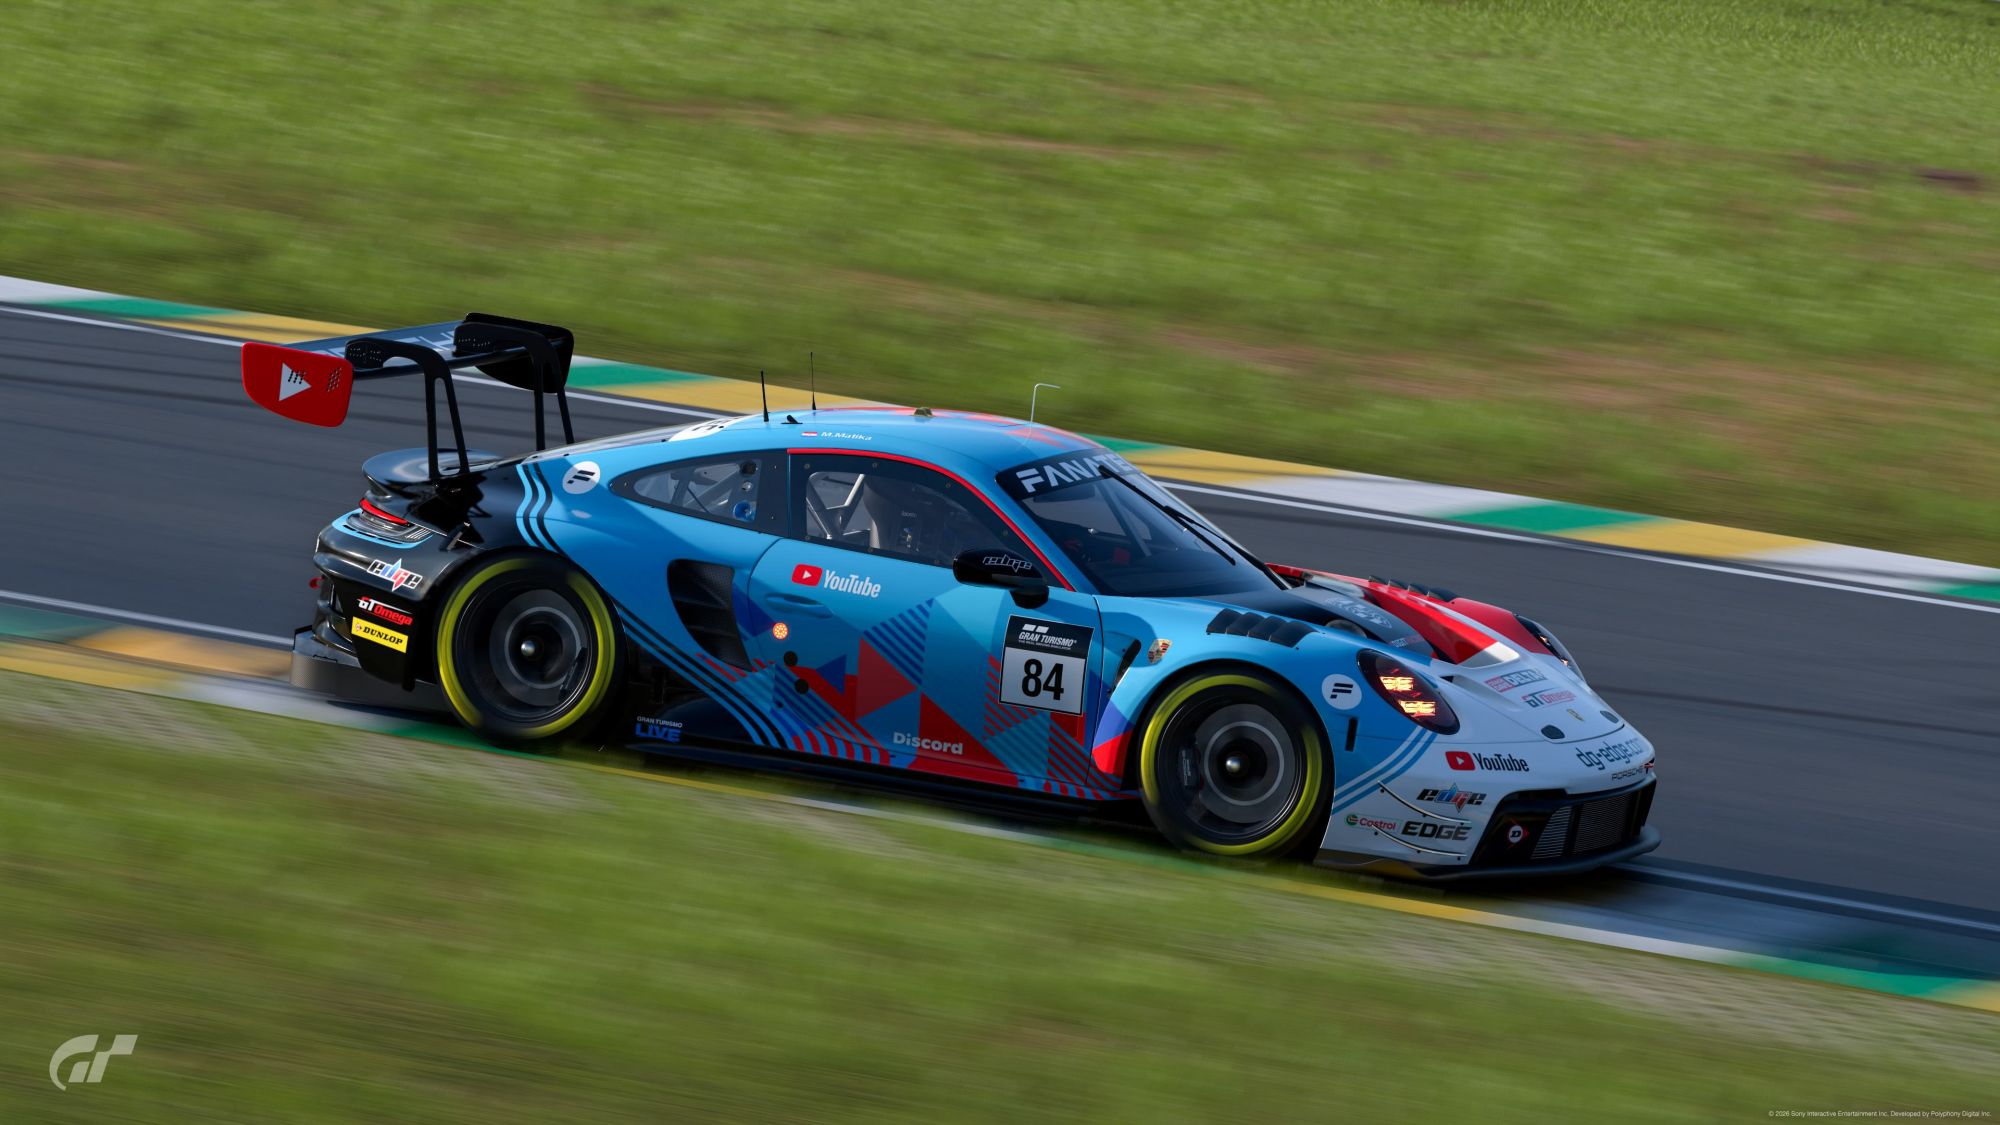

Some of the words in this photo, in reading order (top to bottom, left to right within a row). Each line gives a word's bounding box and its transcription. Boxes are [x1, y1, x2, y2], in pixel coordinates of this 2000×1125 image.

[1016, 453, 1135, 493] FANATE
[824, 569, 882, 598] YouTube
[357, 597, 376, 612] GT
[373, 604, 413, 626] Omega
[363, 626, 403, 646] DUNLOP
[1018, 631, 1040, 643] GRAN
[1021, 658, 1065, 700] 84
[635, 723, 681, 742] LIVE
[636, 715, 655, 724] GRAN
[655, 718, 683, 728] TURISMO
[893, 731, 963, 755] Discord
[1474, 752, 1530, 772] YouTube
[1359, 817, 1397, 830] Castrol
[1401, 820, 1473, 841] EDGE
